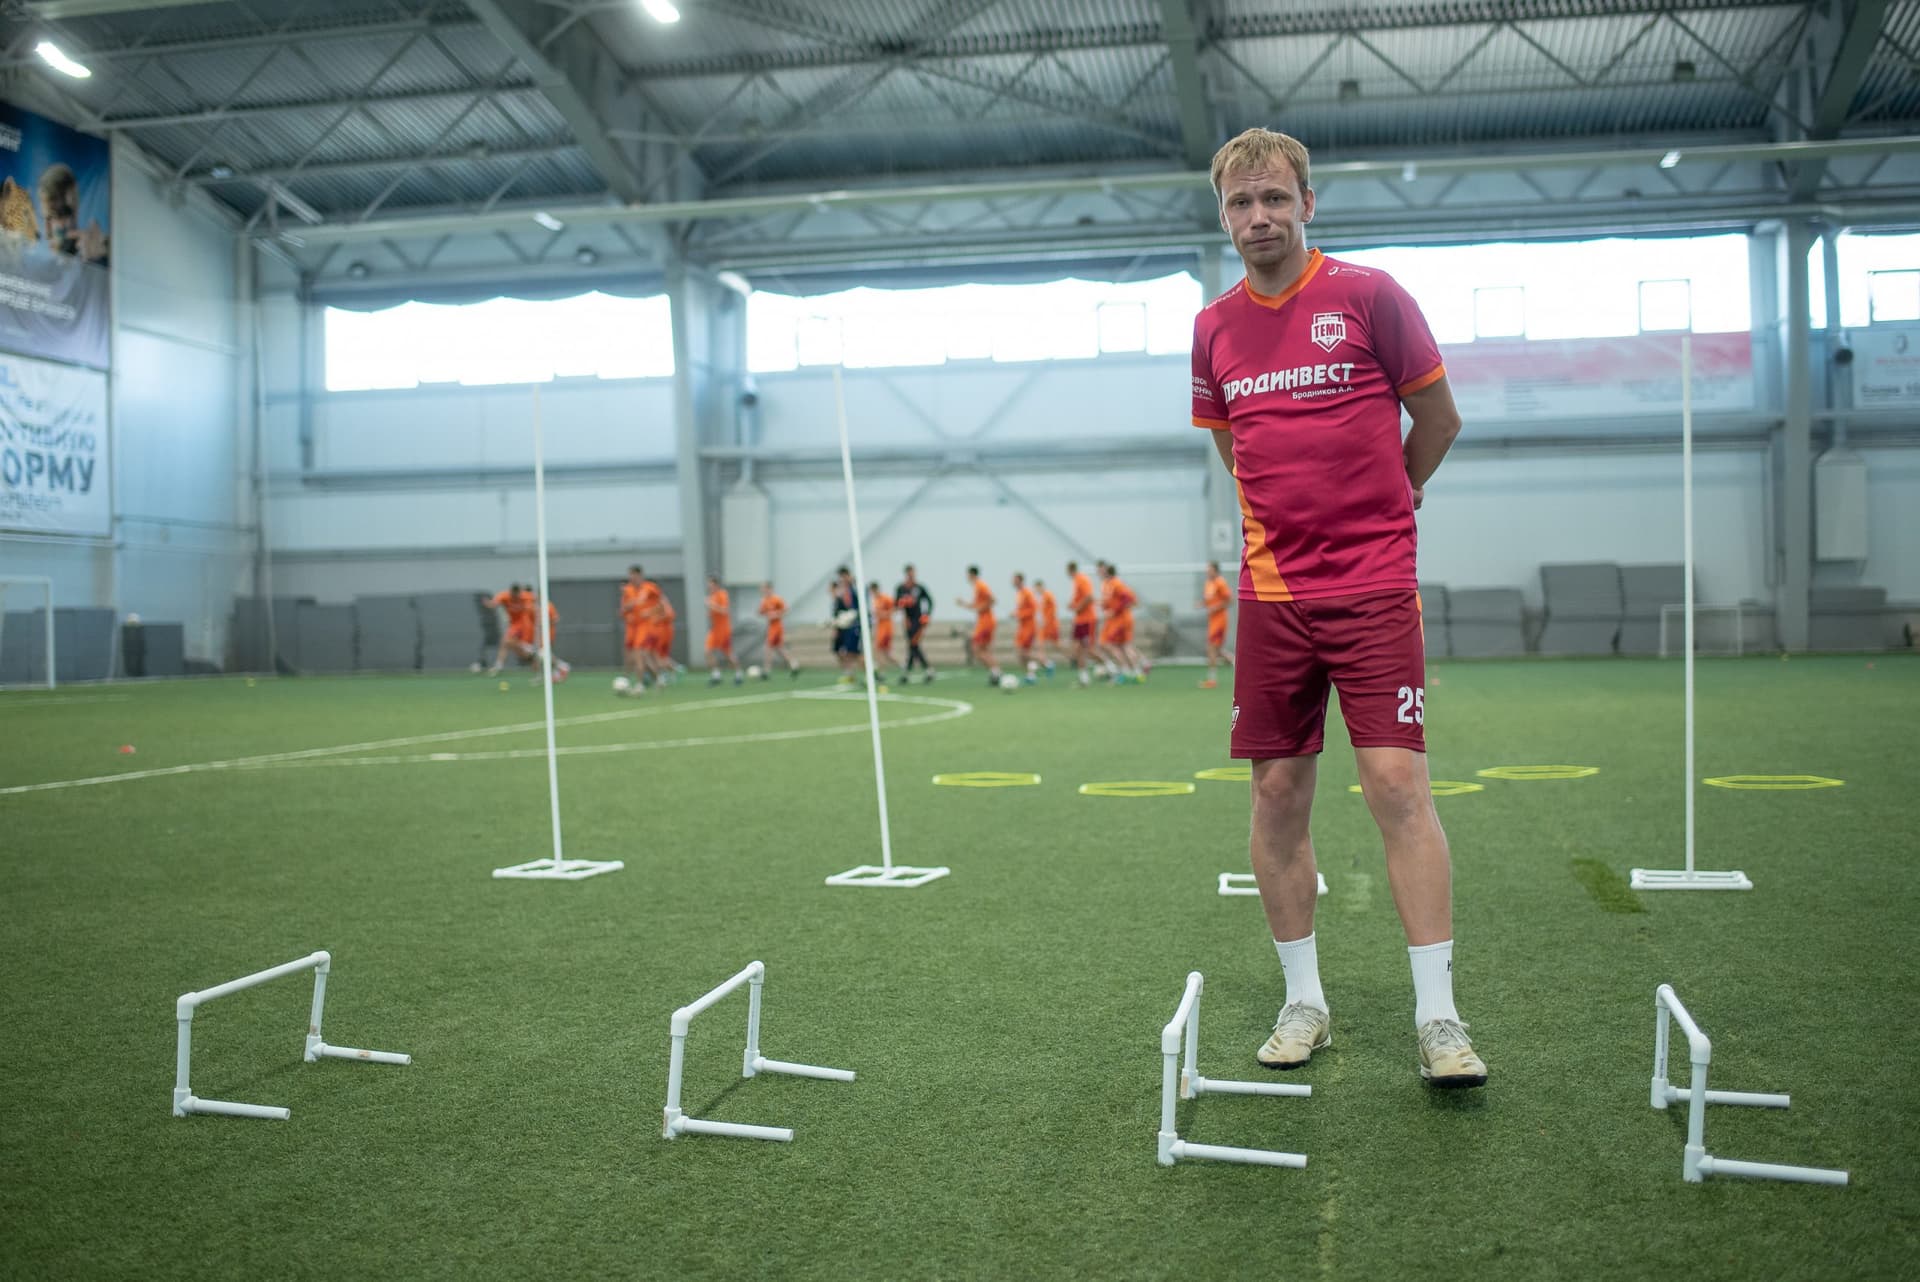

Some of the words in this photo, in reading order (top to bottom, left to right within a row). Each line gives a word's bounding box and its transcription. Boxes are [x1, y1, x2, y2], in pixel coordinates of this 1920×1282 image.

[1313, 323, 1344, 339] ТЕМП
[1222, 362, 1356, 404] ПРОДИНВЕСТ
[1292, 387, 1338, 401] Бродников
[1338, 384, 1355, 394] А.А.
[1397, 685, 1424, 726] 25
